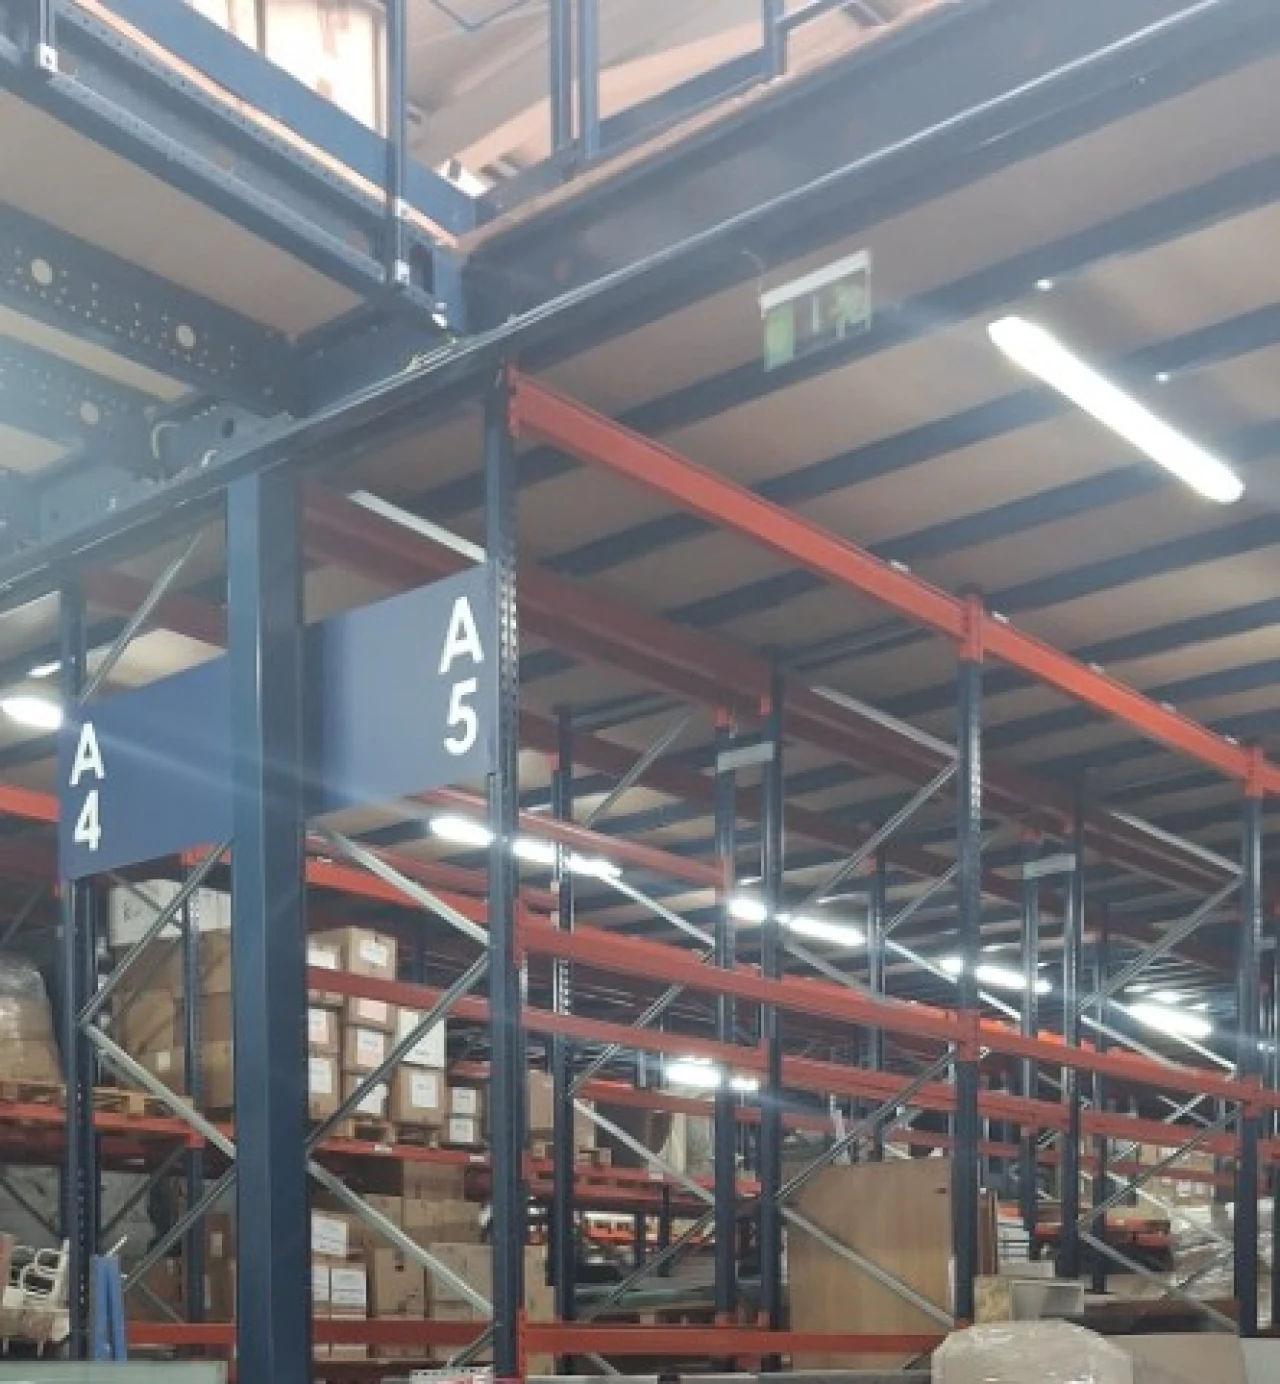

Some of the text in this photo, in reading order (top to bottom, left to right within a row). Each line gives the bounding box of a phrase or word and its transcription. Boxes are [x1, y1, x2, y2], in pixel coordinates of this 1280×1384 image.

[438, 596, 484, 675] A
[444, 676, 478, 756] 5
[69, 721, 105, 787] A
[72, 789, 101, 851] 4
